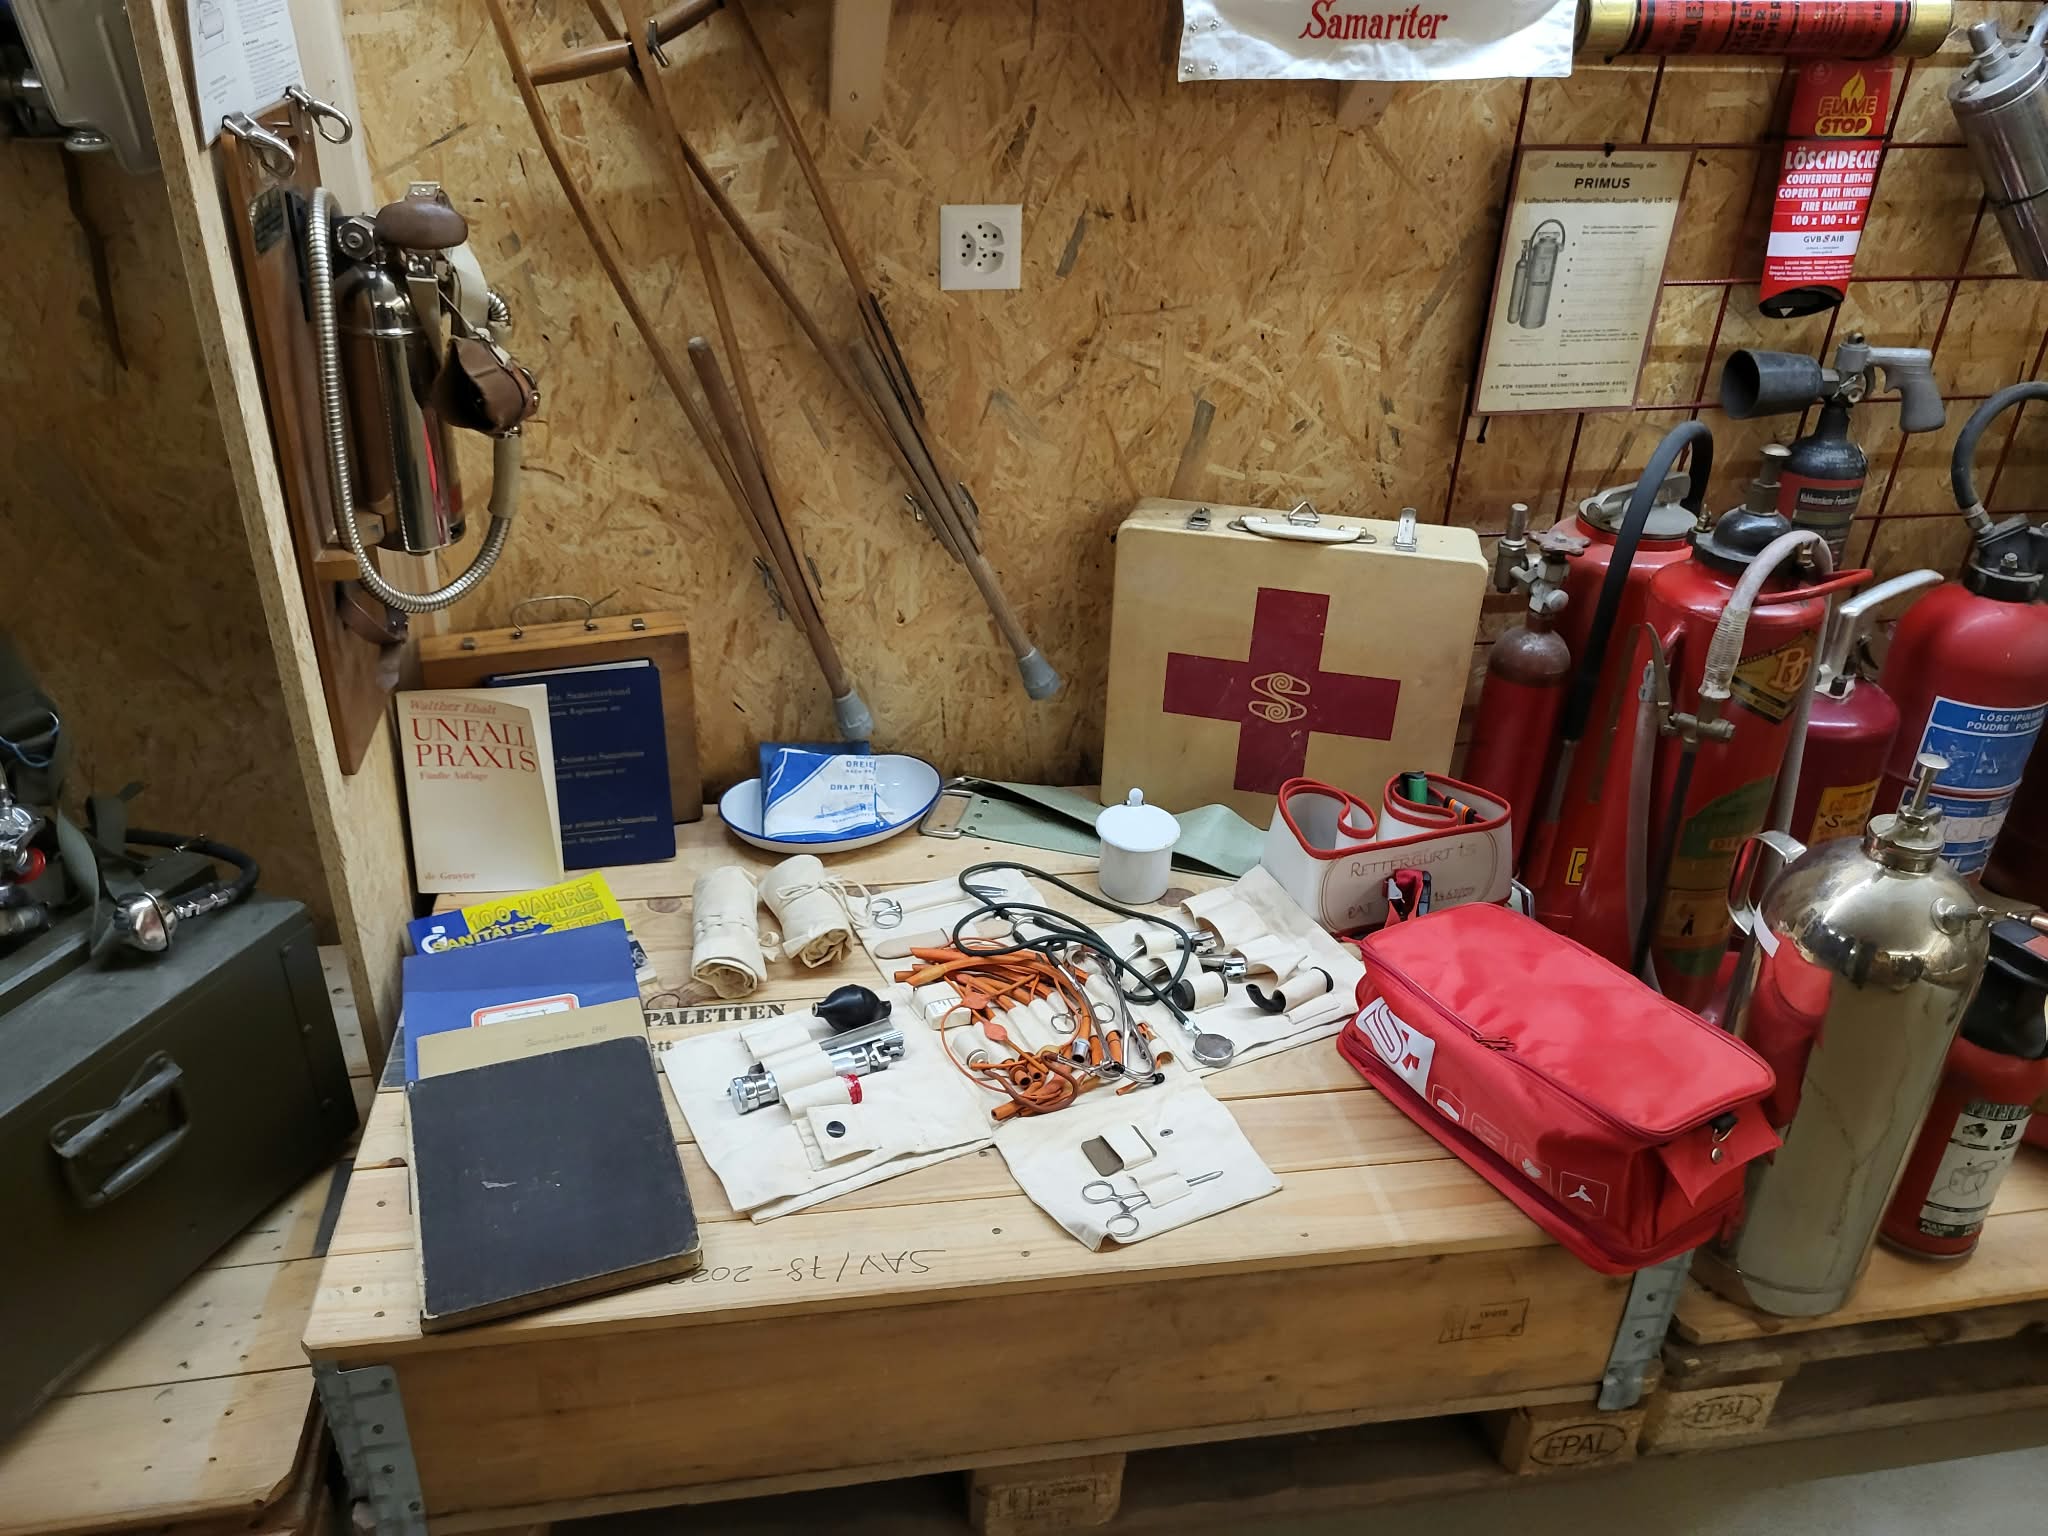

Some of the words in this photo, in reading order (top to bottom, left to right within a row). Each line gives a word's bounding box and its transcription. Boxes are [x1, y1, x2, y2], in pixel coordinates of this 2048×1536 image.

[1298, 0, 1449, 40] Samariter
[1817, 96, 1878, 115] FLAME
[1819, 118, 1870, 134] STOP
[1554, 161, 1585, 170] Anleitung
[1598, 160, 1608, 169] die
[1646, 161, 1658, 169] der
[1573, 177, 1631, 189] PRIMUS
[1786, 173, 1842, 185] COUVERTURE
[1778, 188, 1819, 199] COPERTA
[1820, 187, 1841, 198] ANTI
[1801, 201, 1821, 212] FIRE
[1822, 200, 1857, 211] BLANKET
[1791, 215, 1809, 226] 100
[1821, 214, 1837, 225] 100
[1803, 235, 1822, 244] GVB
[410, 700, 461, 713] Walther
[411, 717, 536, 749] UNFALL
[1966, 720, 2010, 732] POUDRE
[415, 743, 538, 773] PRAXIS
[466, 904, 512, 933] 100
[517, 881, 599, 919] JAHRE
[431, 899, 604, 952] SANITÄTSPOLIZEI
[644, 1003, 786, 1027] PALETTEN
[1694, 1399, 1745, 1425] EPAL
[1543, 1433, 1609, 1458] EPAL
